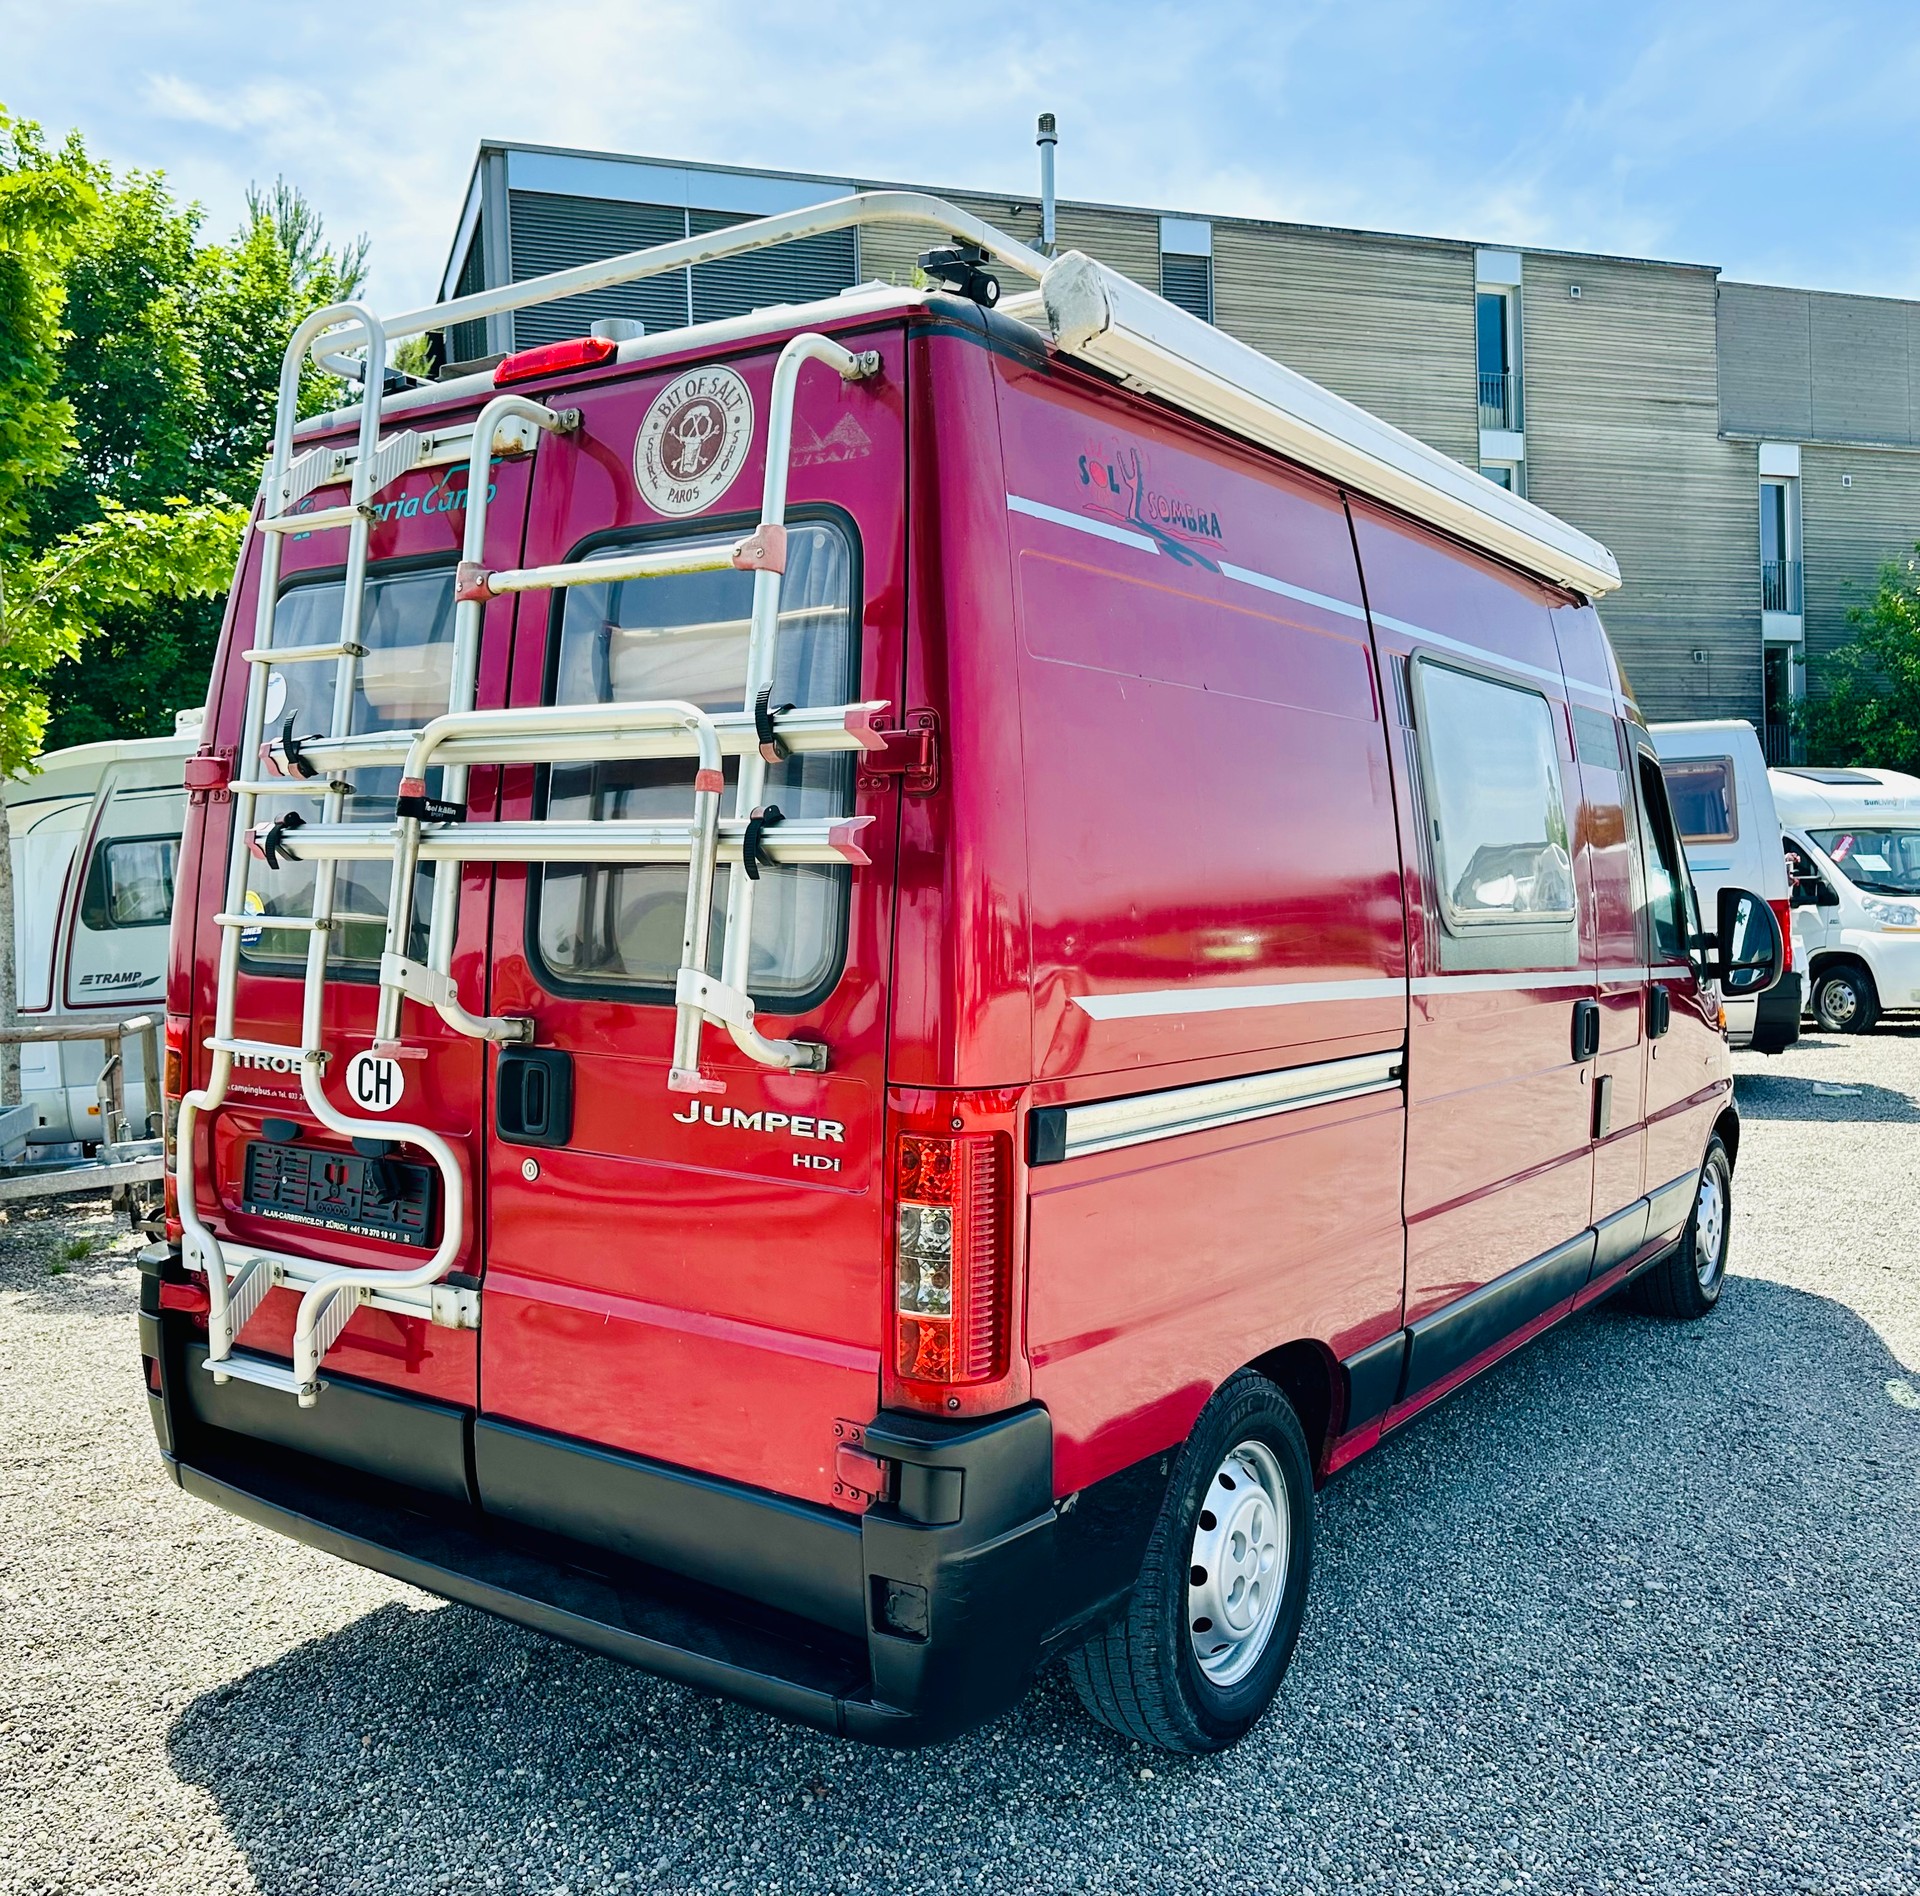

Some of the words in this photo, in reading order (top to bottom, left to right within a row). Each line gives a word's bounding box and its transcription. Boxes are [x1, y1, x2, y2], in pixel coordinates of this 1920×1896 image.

[657, 386, 682, 419] BIT
[685, 377, 708, 397] OF
[708, 377, 744, 412] SALT
[646, 437, 659, 490] SURF
[710, 429, 740, 485] SHOP
[1078, 455, 1120, 494] SOL
[667, 486, 700, 503] PAROS
[1148, 491, 1223, 539] SOMBRA
[95, 971, 142, 984] TRAMP
[357, 1057, 393, 1105] CH
[672, 1100, 845, 1143] JUMPER
[325, 1219, 348, 1231] ZÜRICH
